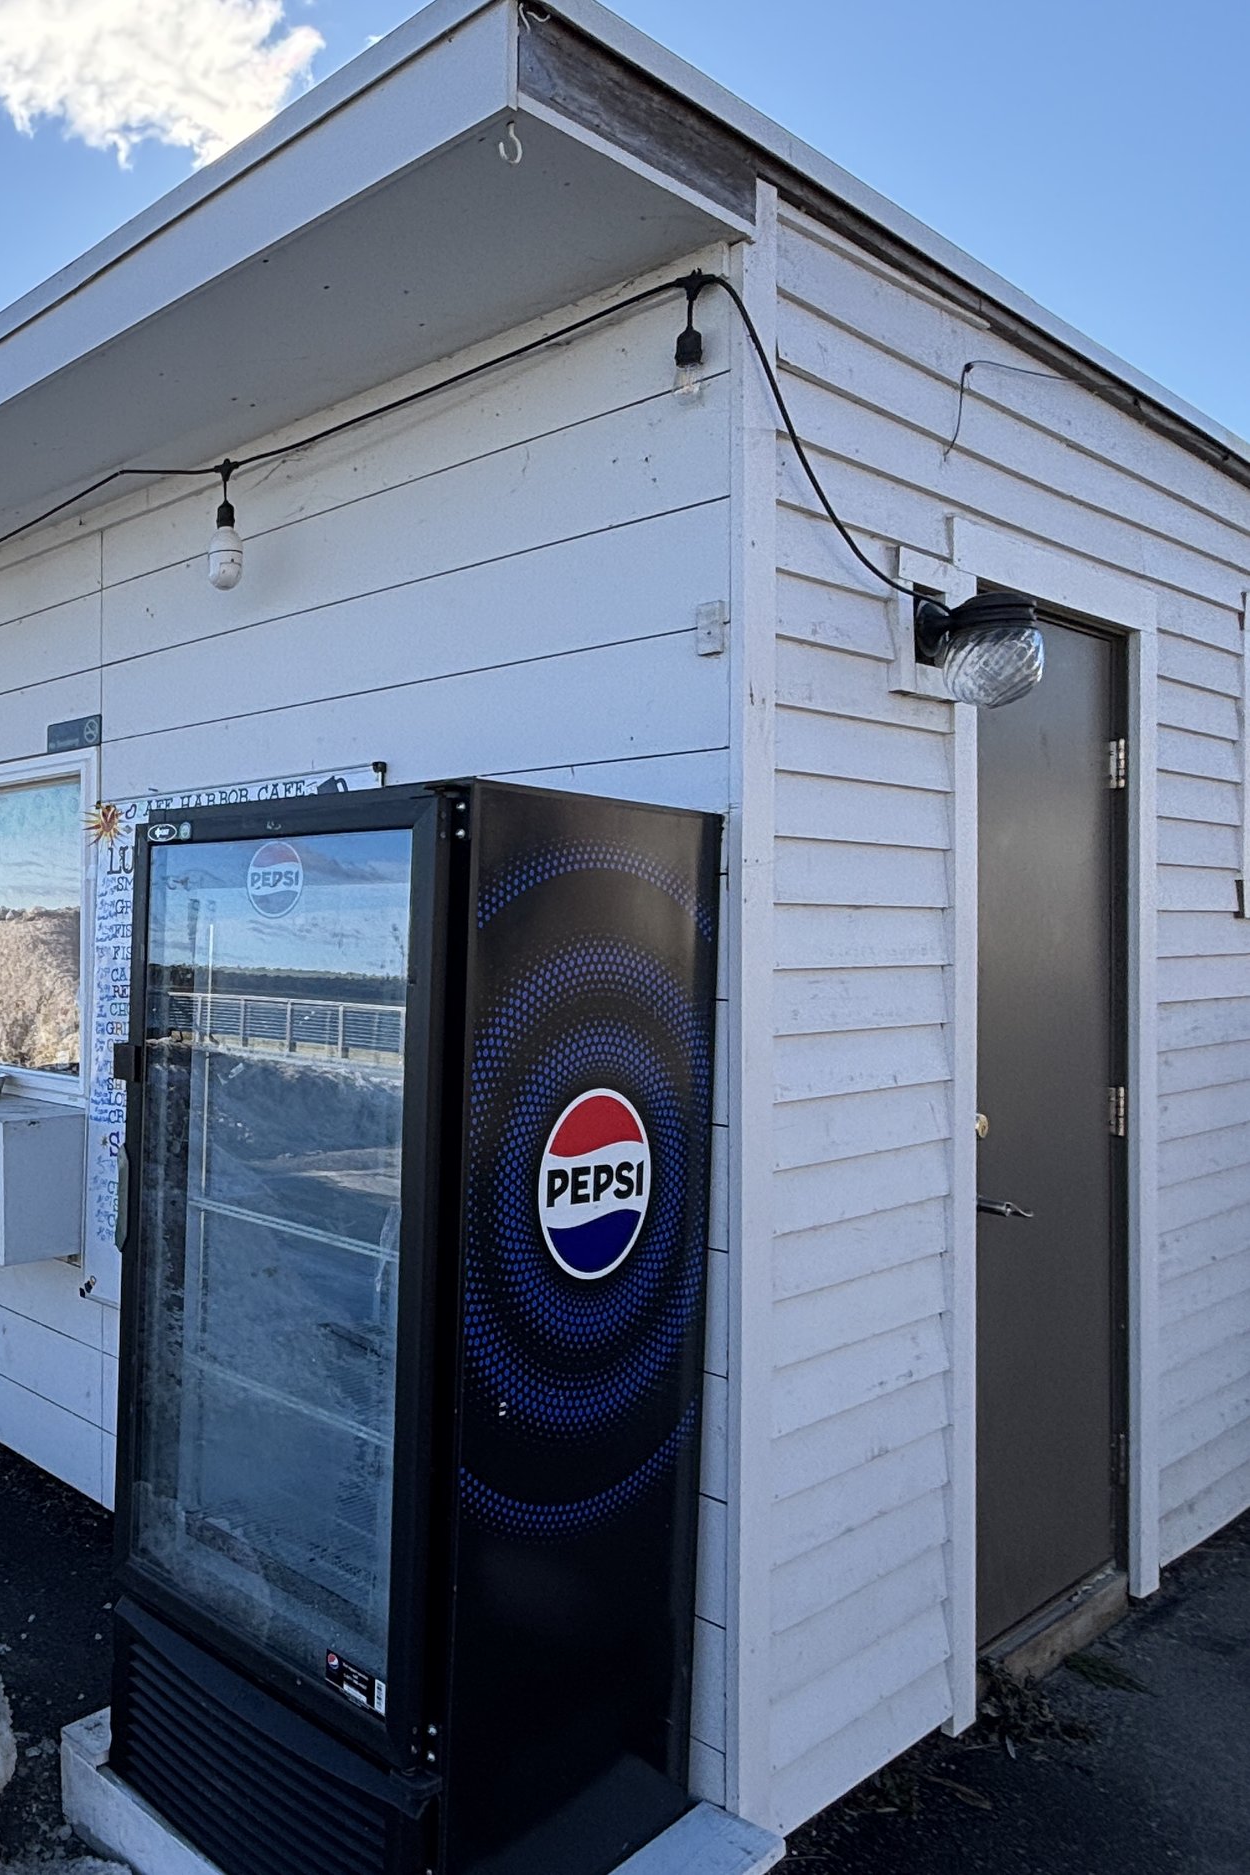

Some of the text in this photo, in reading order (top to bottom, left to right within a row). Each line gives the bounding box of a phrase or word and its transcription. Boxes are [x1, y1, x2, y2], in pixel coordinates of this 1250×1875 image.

[258, 780, 306, 802] CAFE
[251, 870, 299, 888] PEPSI
[546, 1159, 645, 1208] PEPSI
